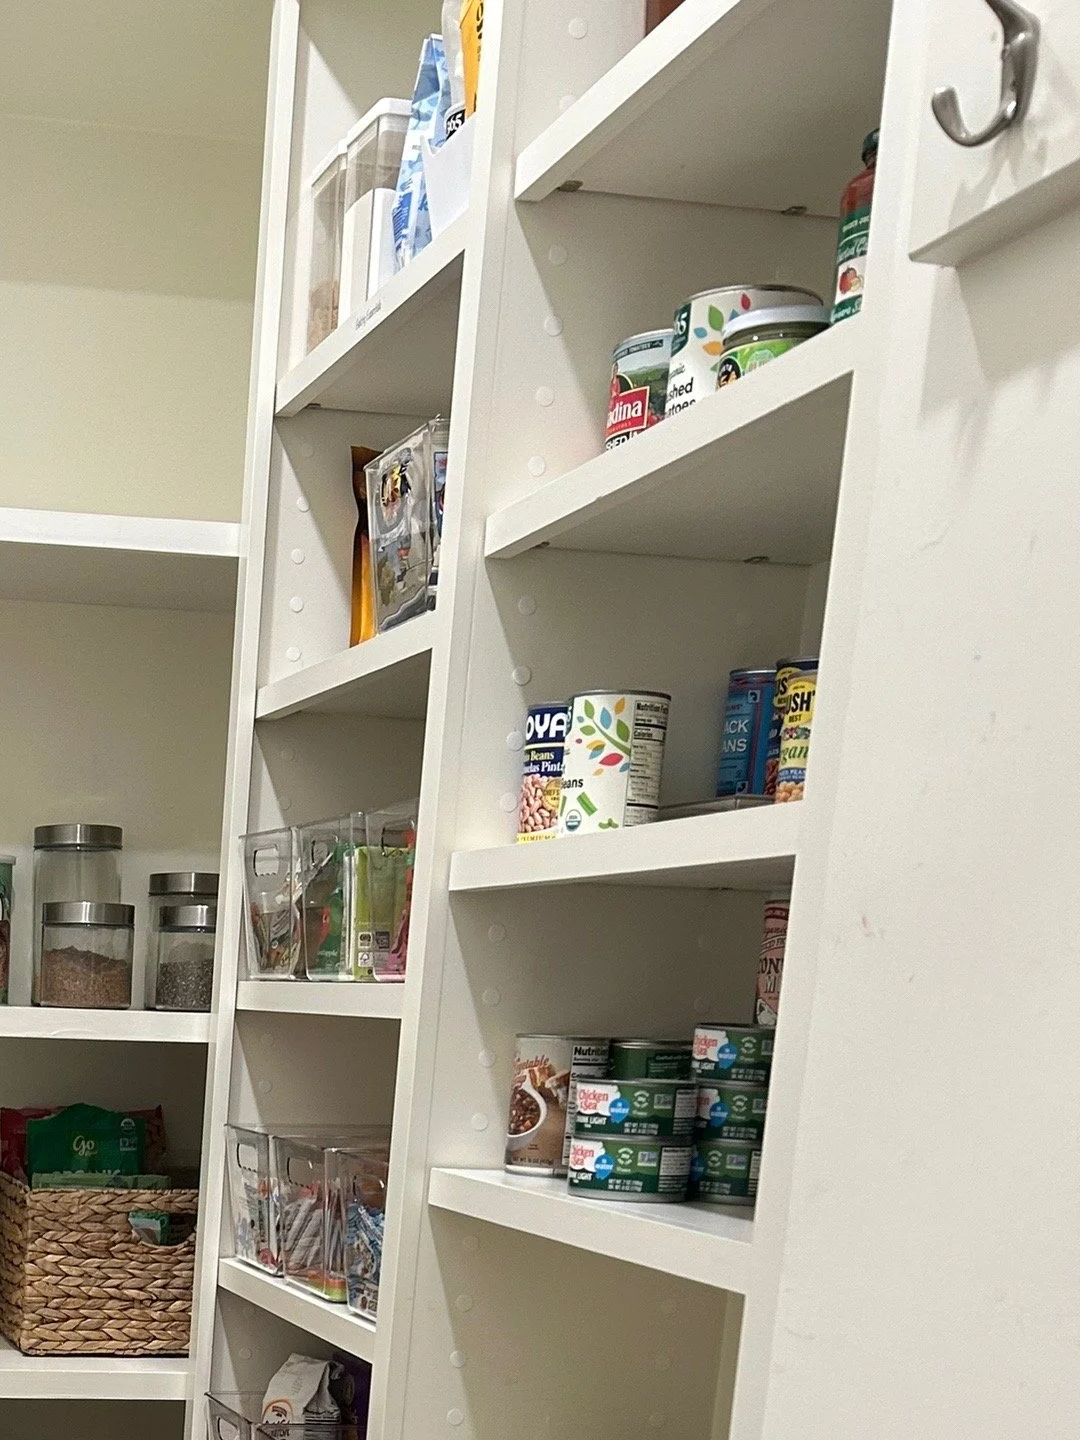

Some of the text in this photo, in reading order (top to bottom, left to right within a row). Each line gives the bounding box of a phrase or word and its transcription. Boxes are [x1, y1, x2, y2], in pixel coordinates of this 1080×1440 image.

[526, 712, 567, 740] OYA
[530, 751, 554, 761] Beans
[562, 778, 584, 789] eans
[73, 1136, 94, 1156] Go
